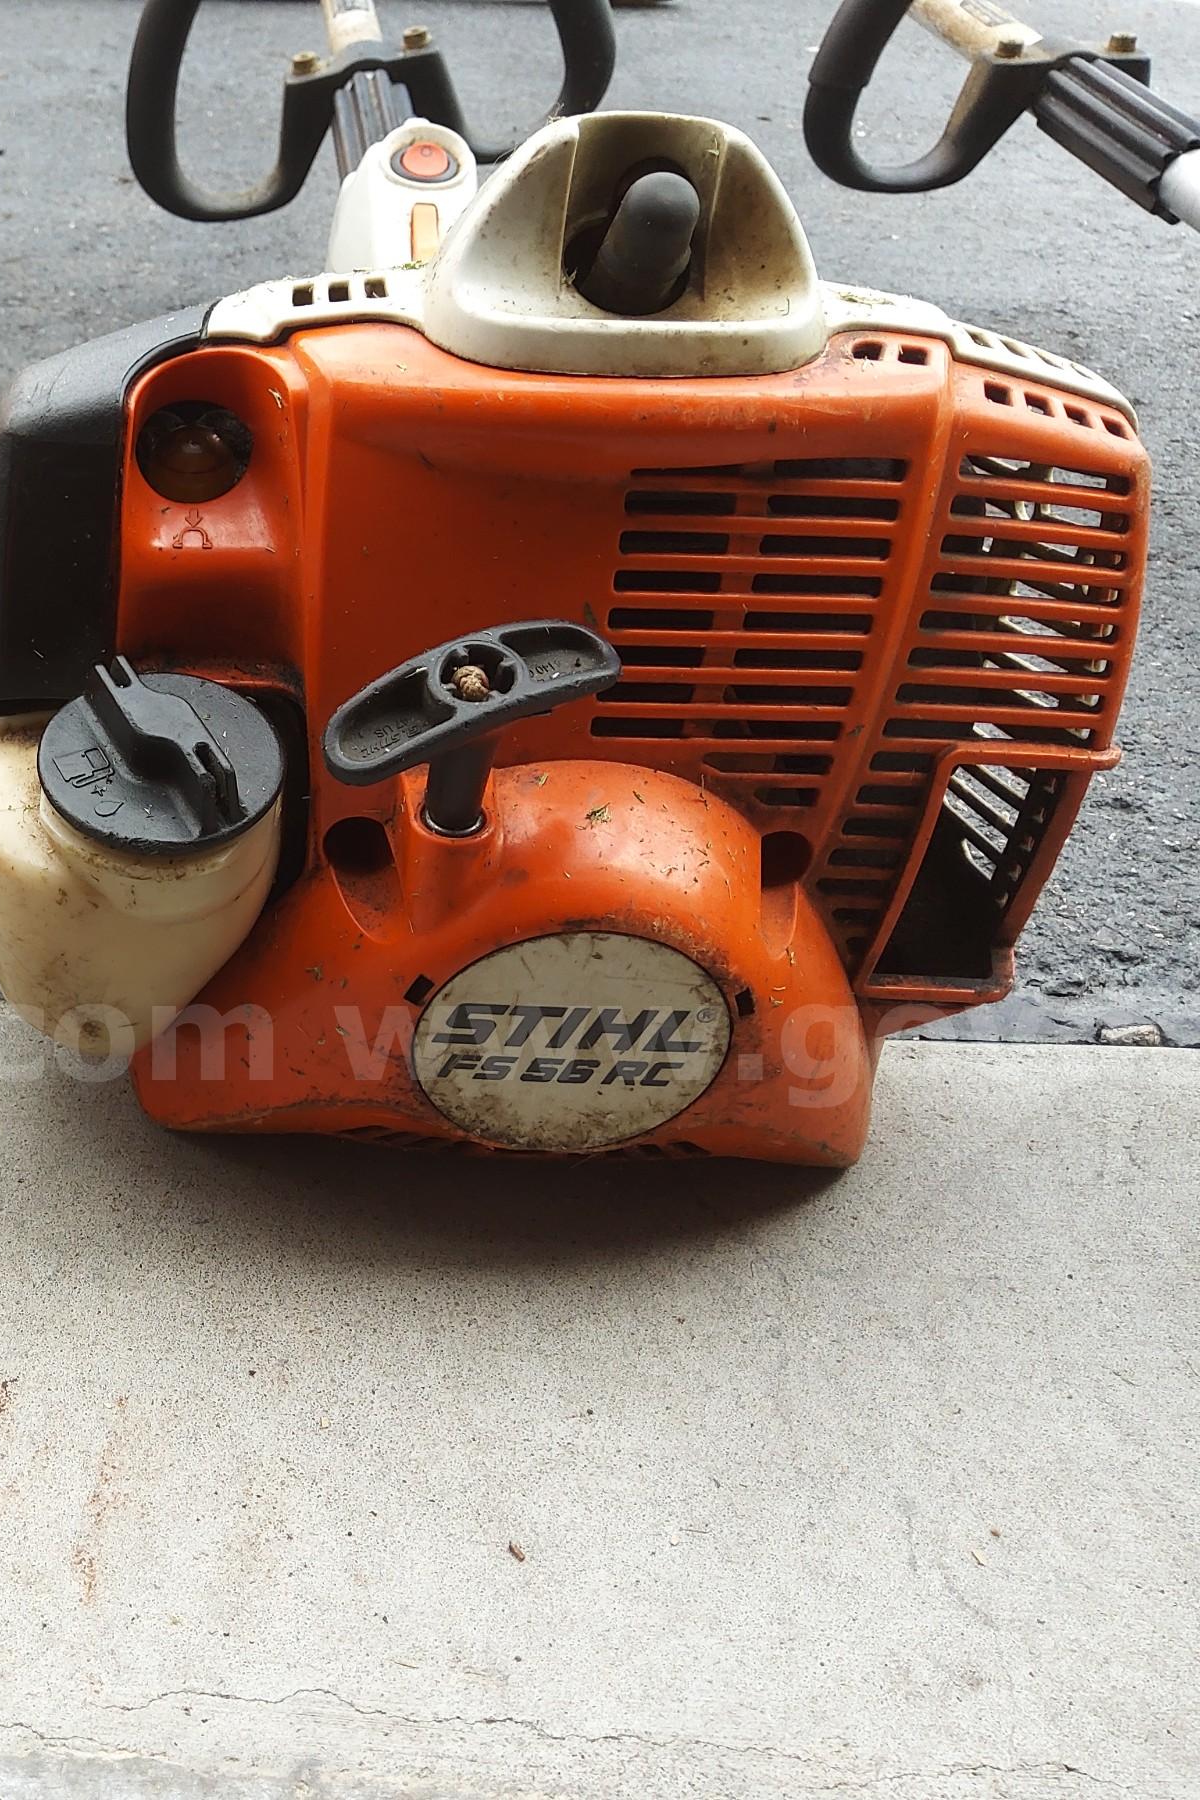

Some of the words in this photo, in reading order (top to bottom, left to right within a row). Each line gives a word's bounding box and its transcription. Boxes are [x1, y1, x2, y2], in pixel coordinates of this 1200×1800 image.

[432, 1003, 701, 1053] STIHL
[437, 1053, 519, 1081] FS
[519, 1057, 601, 1084] 56
[601, 1060, 685, 1087] RC
